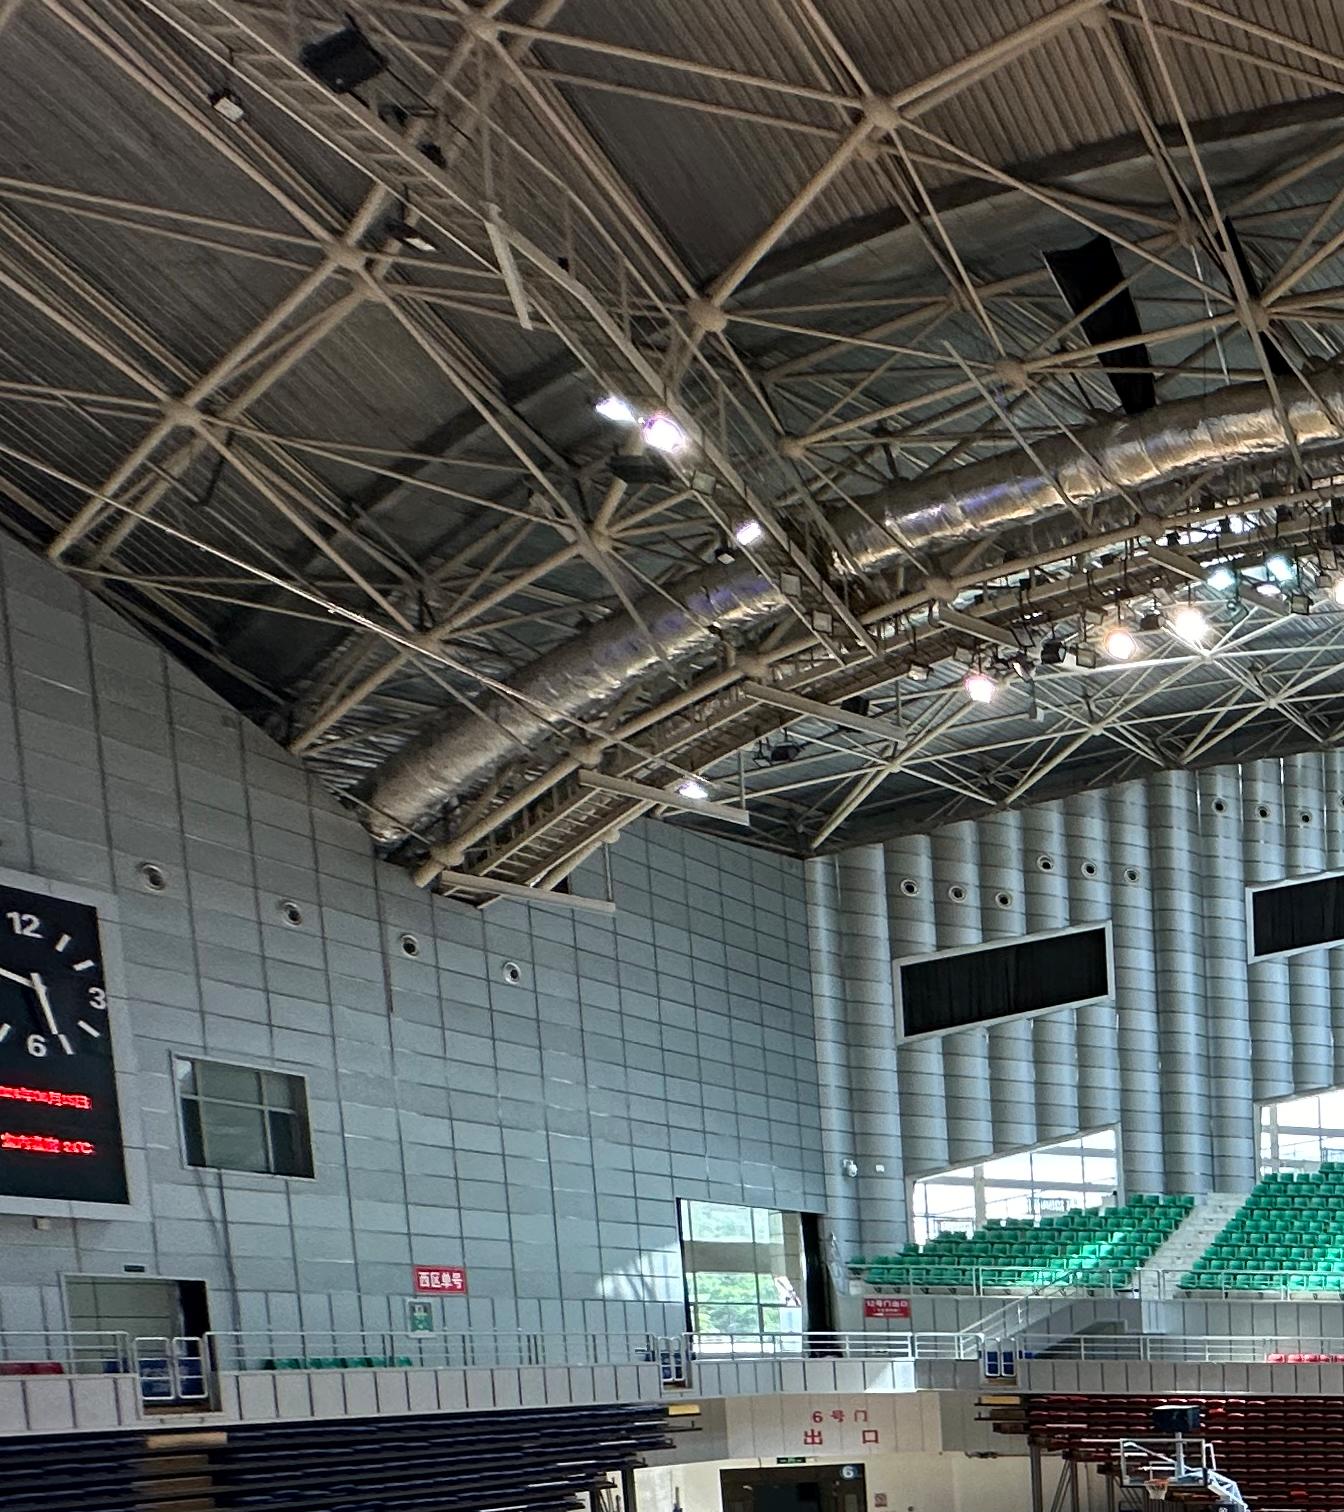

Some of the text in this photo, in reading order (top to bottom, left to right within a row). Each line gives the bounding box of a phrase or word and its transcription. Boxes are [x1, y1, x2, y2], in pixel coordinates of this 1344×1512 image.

[6, 911, 44, 938] 12
[89, 987, 106, 1010] 3
[27, 1034, 47, 1057] 6
[418, 1272, 463, 1289] 西区单号
[812, 1410, 868, 1423] 6号门
[804, 1429, 880, 1445] 出口
[842, 1465, 855, 1479] 6
